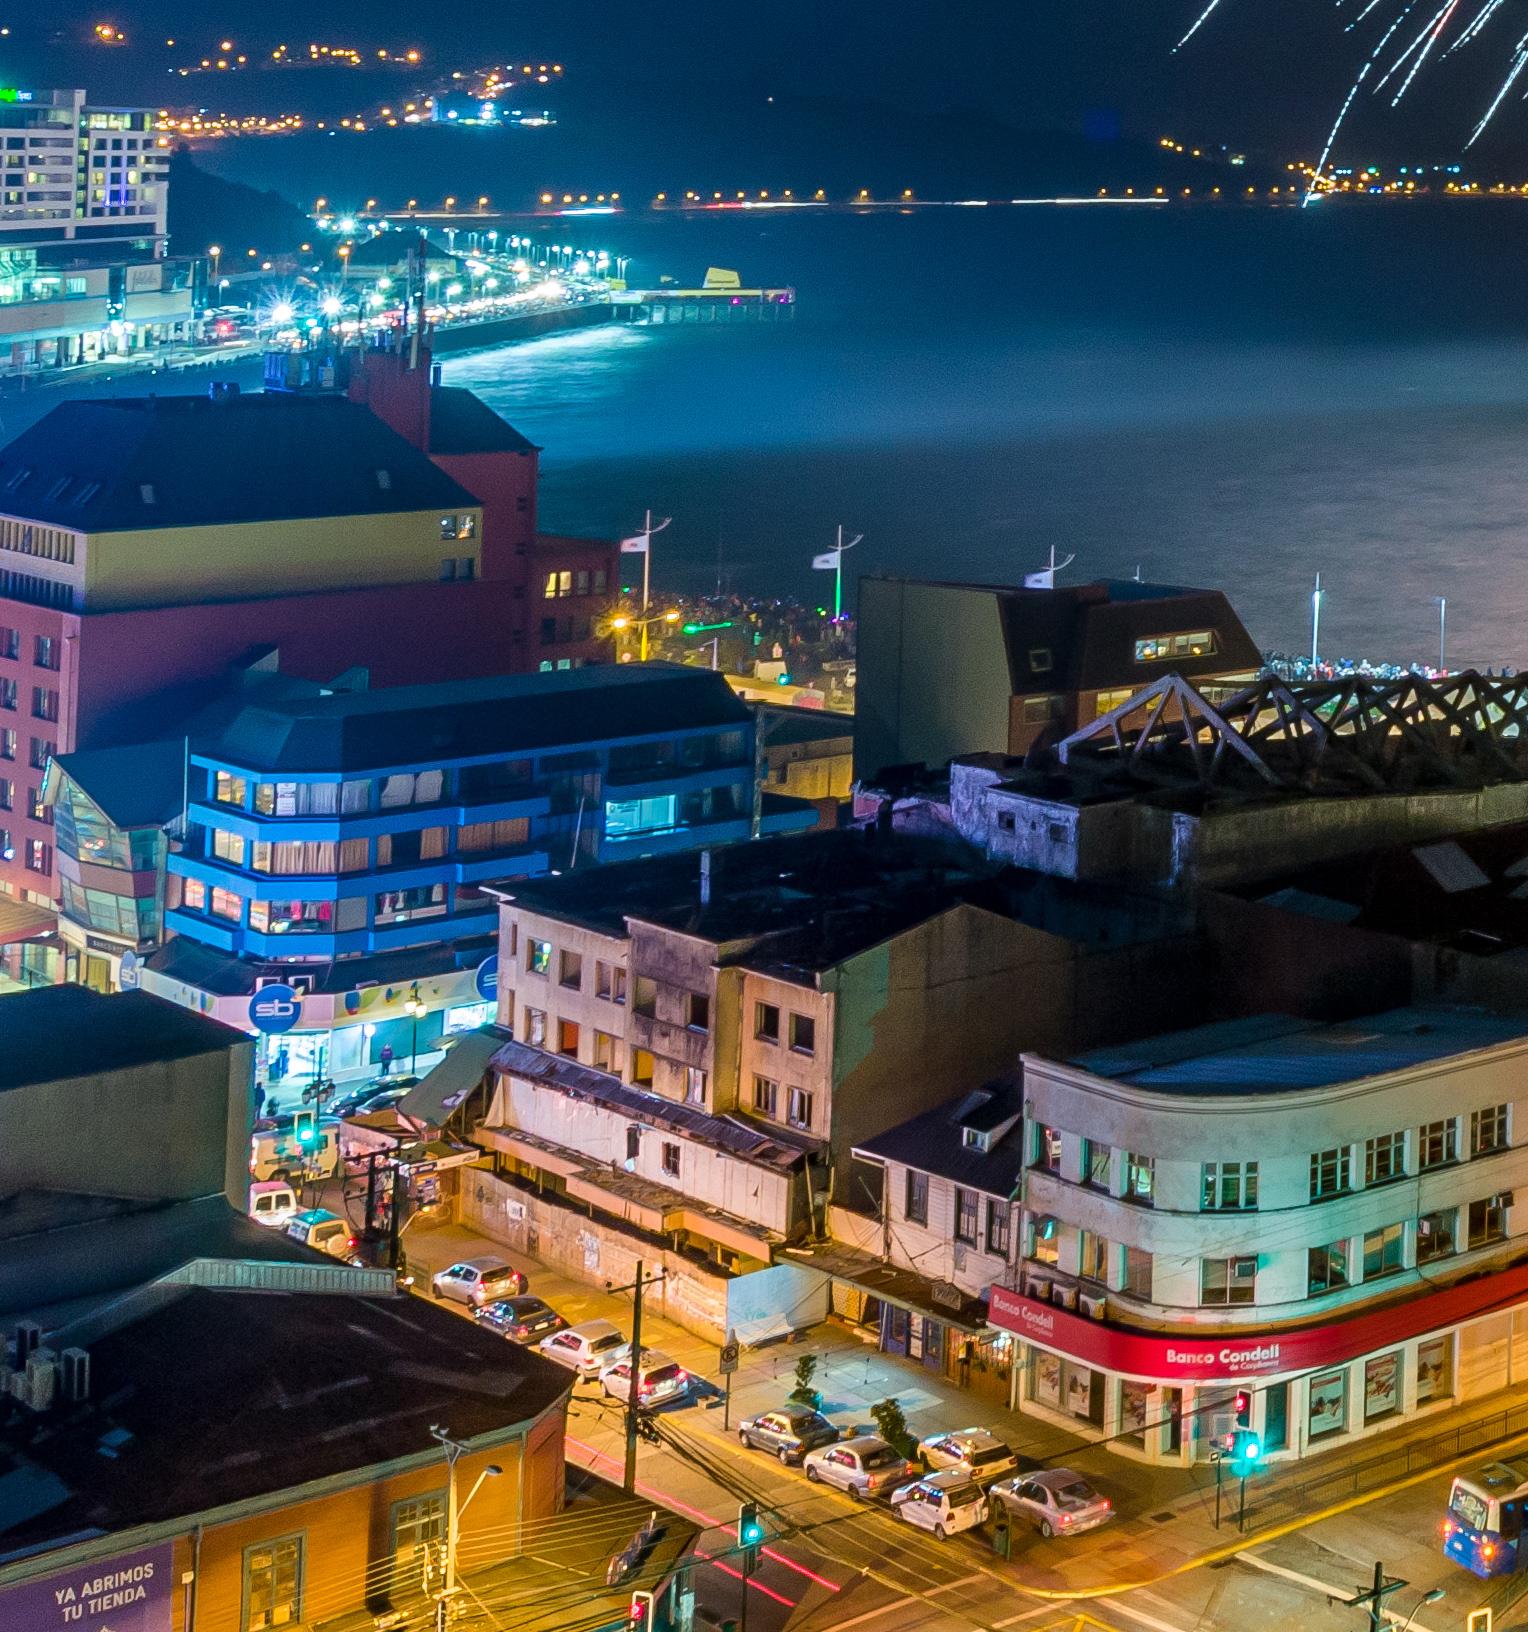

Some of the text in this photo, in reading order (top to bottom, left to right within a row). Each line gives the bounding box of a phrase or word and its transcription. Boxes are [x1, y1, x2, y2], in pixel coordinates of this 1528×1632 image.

[256, 999, 295, 1016] sb
[1166, 1344, 1280, 1364] Banco Condell
[55, 1563, 154, 1605] YA ABRIMOS
[62, 1585, 146, 1623] TU TIENDA
